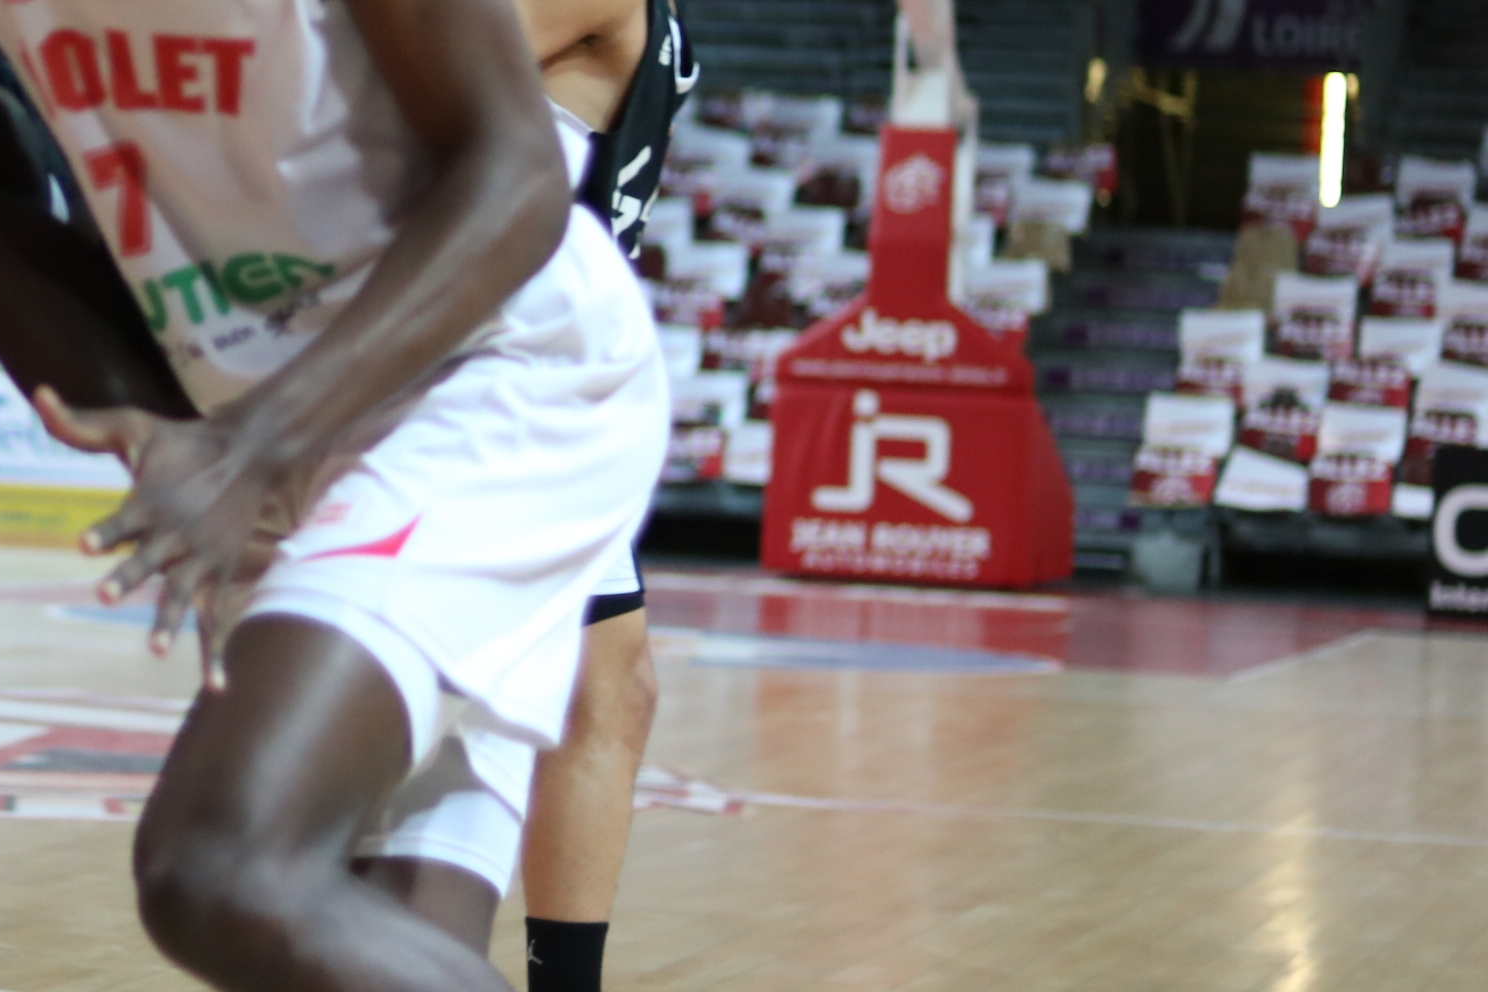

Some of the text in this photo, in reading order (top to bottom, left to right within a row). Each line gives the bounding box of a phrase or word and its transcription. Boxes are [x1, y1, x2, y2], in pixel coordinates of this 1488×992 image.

[20, 28, 256, 117] OLET
[82, 139, 154, 259] 7
[841, 309, 959, 364] Jeep
[790, 517, 867, 555] JEAN
